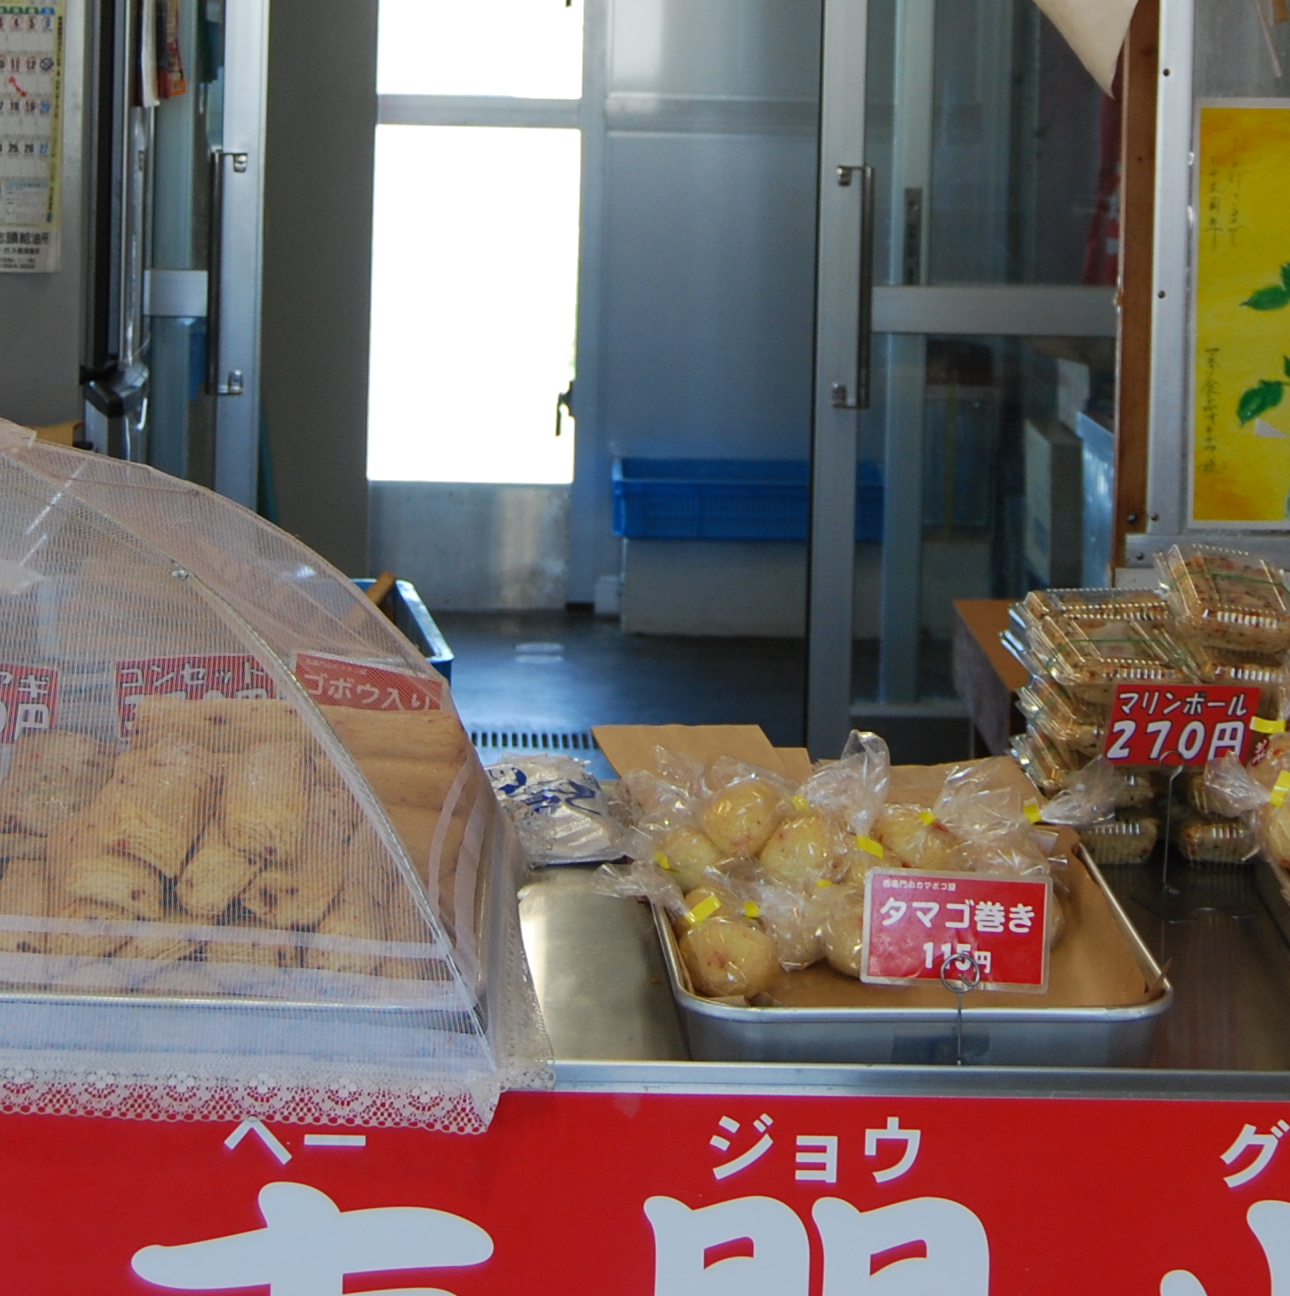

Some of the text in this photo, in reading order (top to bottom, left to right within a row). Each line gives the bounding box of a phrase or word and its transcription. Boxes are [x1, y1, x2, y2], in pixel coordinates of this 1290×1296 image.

[1118, 691, 1248, 718] マリンボール
[1107, 719, 1245, 761] 270円
[880, 897, 1036, 935] タマゴ巻き
[922, 941, 992, 975] 115円
[709, 1115, 922, 1185] ジョウ
